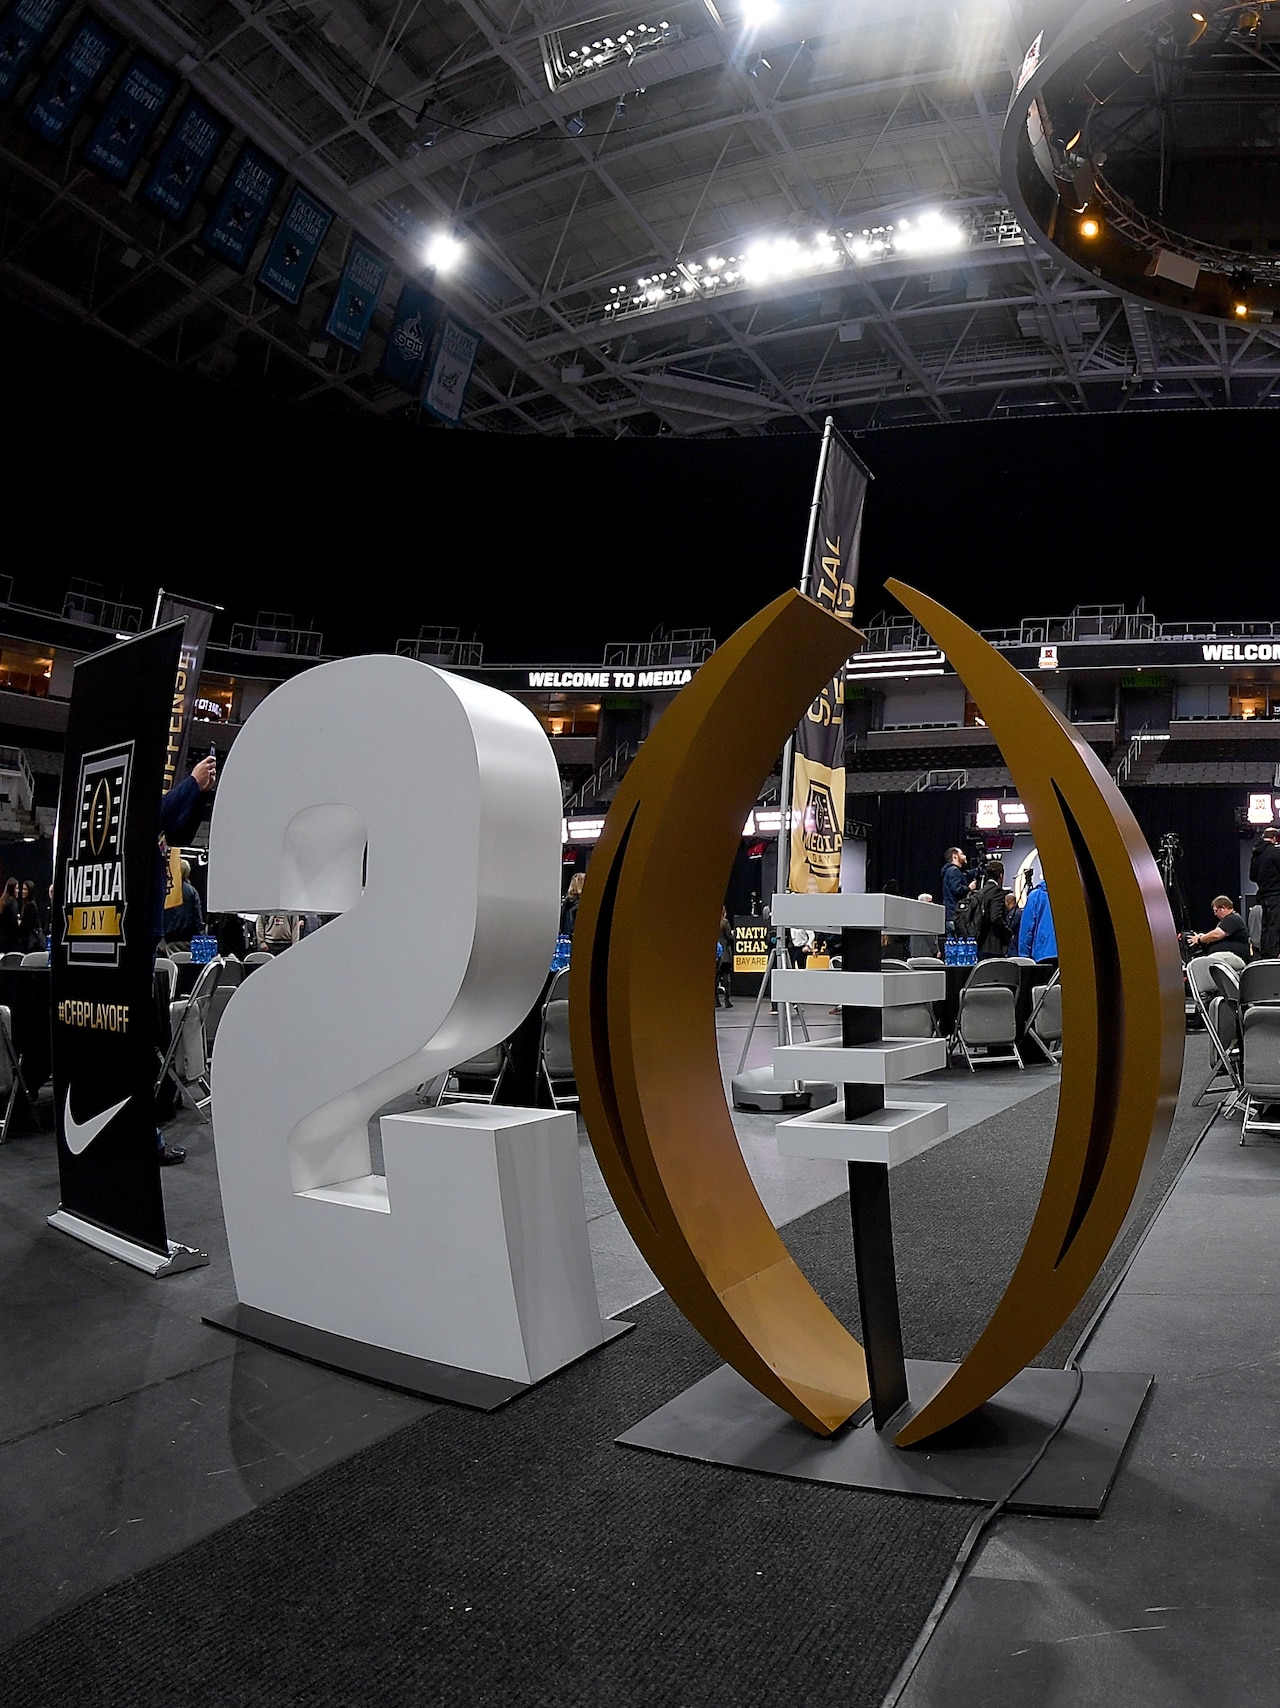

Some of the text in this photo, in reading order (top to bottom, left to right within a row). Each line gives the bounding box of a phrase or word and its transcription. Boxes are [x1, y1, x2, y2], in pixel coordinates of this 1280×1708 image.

[123, 77, 162, 111] TROPHY
[188, 110, 217, 140] PACIFIC
[238, 168, 271, 199] DIVISION
[242, 158, 275, 187] PACIFIC
[289, 211, 321, 239] DIVISION
[295, 200, 327, 229] PACIFIC
[354, 251, 384, 276] PACIFIC
[528, 669, 692, 688] WELCOME TO MEDIA
[803, 831, 843, 853] MEDIA
[67, 861, 123, 904] MEDIA
[82, 910, 105, 931] DAY
[735, 926, 768, 939] NATI
[736, 956, 755, 966] BAY
[58, 999, 129, 1034] #CFBPLAYOFF
